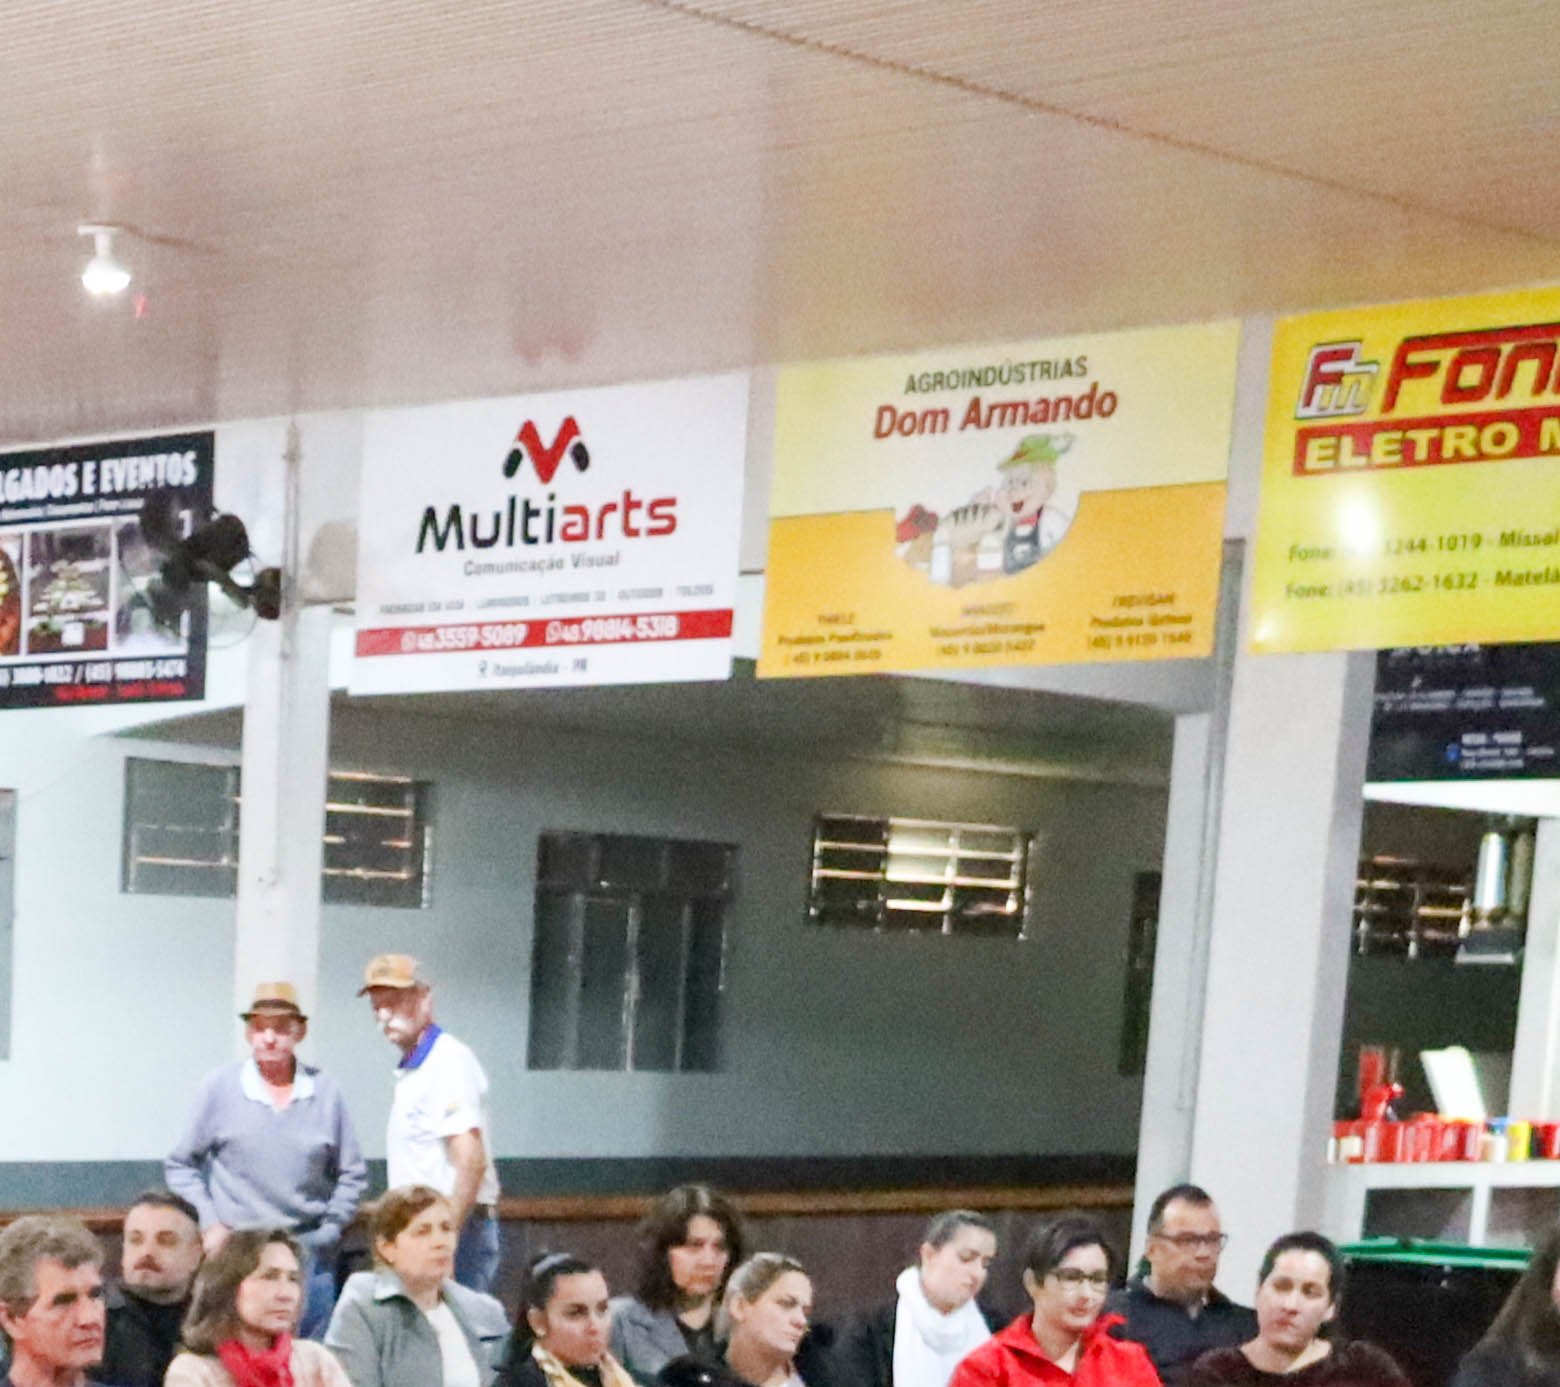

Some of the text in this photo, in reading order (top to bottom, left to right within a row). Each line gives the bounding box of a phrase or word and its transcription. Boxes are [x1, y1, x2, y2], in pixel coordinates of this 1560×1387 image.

[905, 356, 1088, 394] AGROINDÚSTRIAS
[873, 381, 1119, 439] Dom Armando
[1304, 422, 1520, 472] ELETRO
[82, 461, 97, 494] E
[100, 450, 197, 494] EVENTOS
[415, 490, 678, 554] Multiarts
[1499, 528, 1560, 547] Missal
[463, 550, 621, 578] Comunicação Visual
